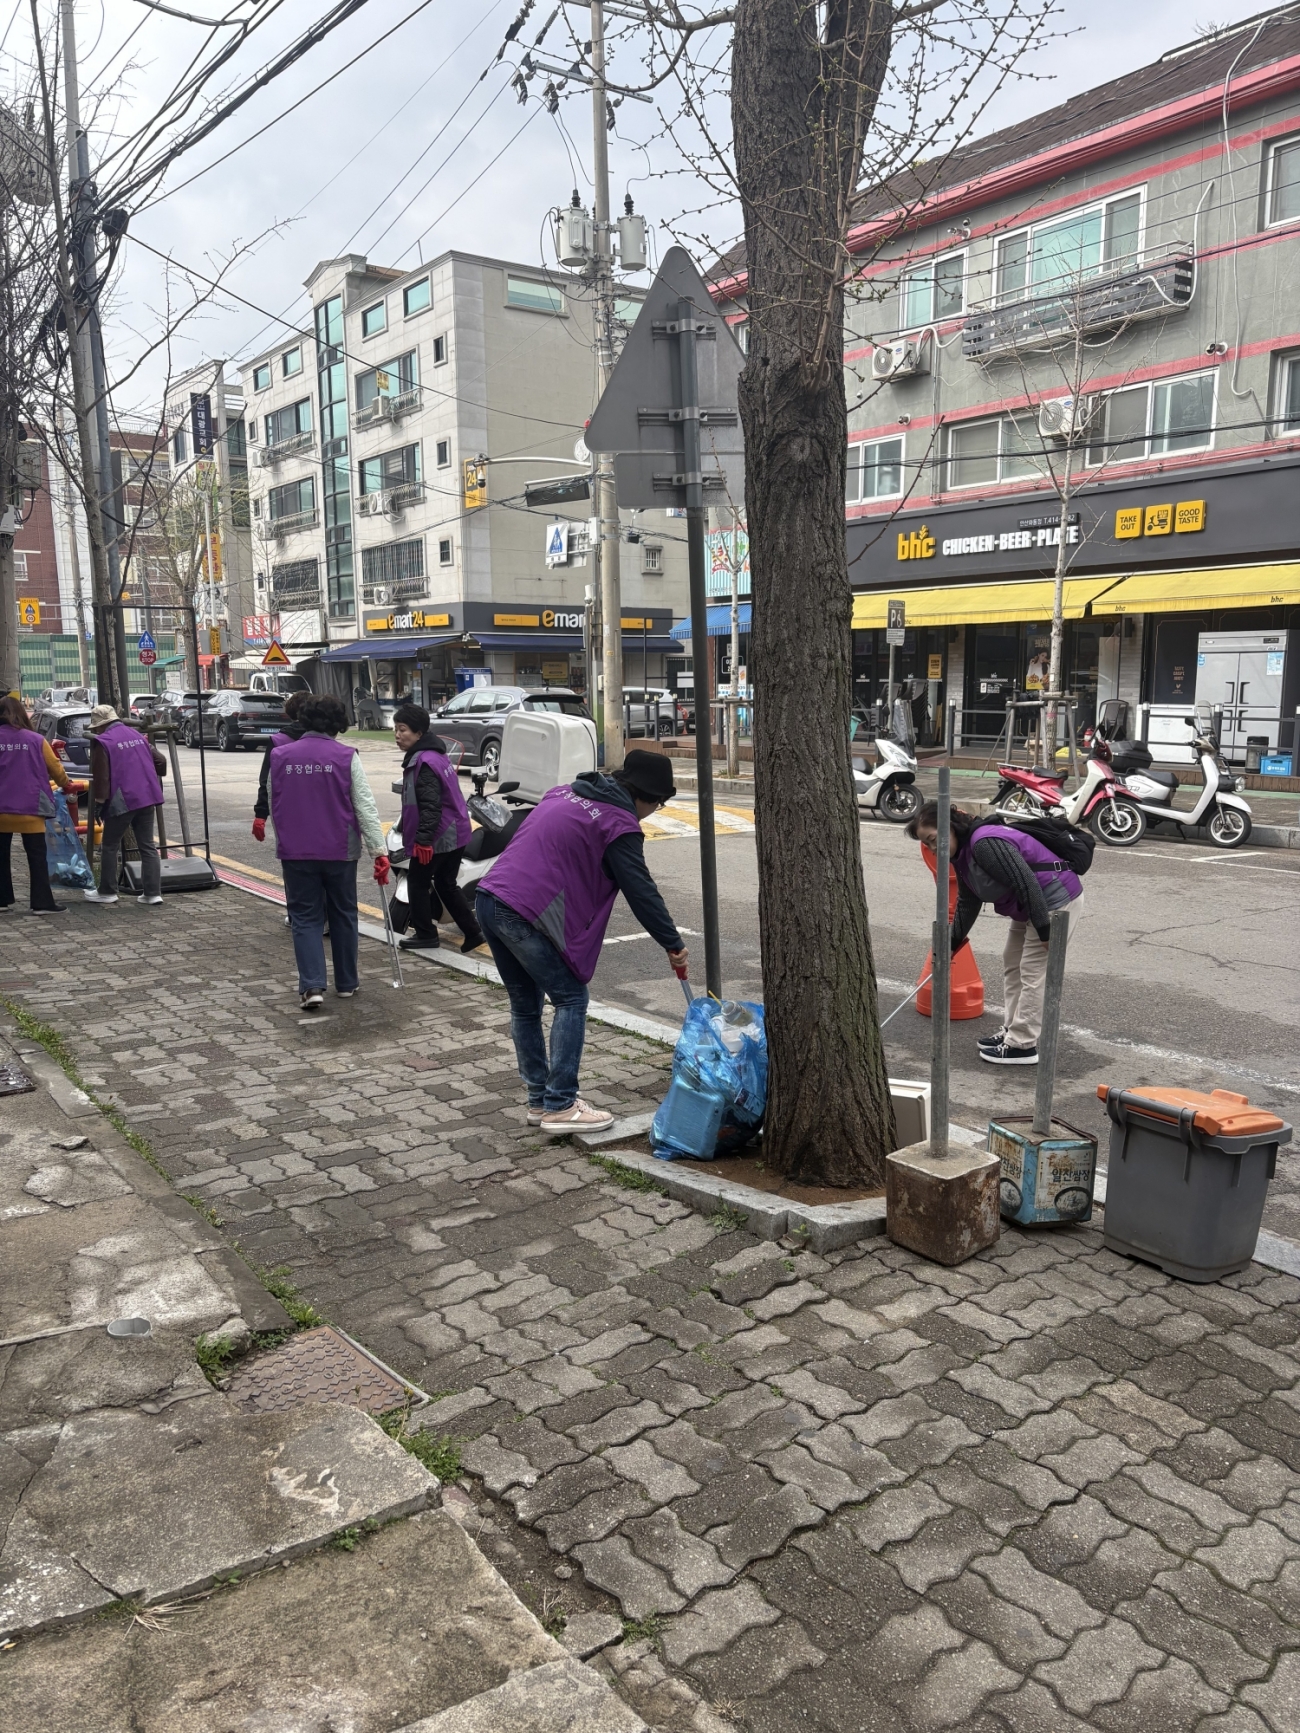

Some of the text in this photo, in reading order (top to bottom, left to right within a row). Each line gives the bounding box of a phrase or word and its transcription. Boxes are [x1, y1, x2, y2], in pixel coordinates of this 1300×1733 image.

[467, 471, 477, 487] 24
[1178, 508, 1200, 517] GOOD
[1044, 514, 1075, 524] T.414-82
[1120, 515, 1137, 524] TAKE
[1178, 516, 1200, 524] TASTE
[1120, 523, 1135, 531] OUT
[897, 525, 935, 561] bhc
[1115, 604, 1126, 612] bhc
[388, 610, 424, 630] emart24
[542, 610, 584, 628] emar
[285, 764, 333, 775] 통장협의회
